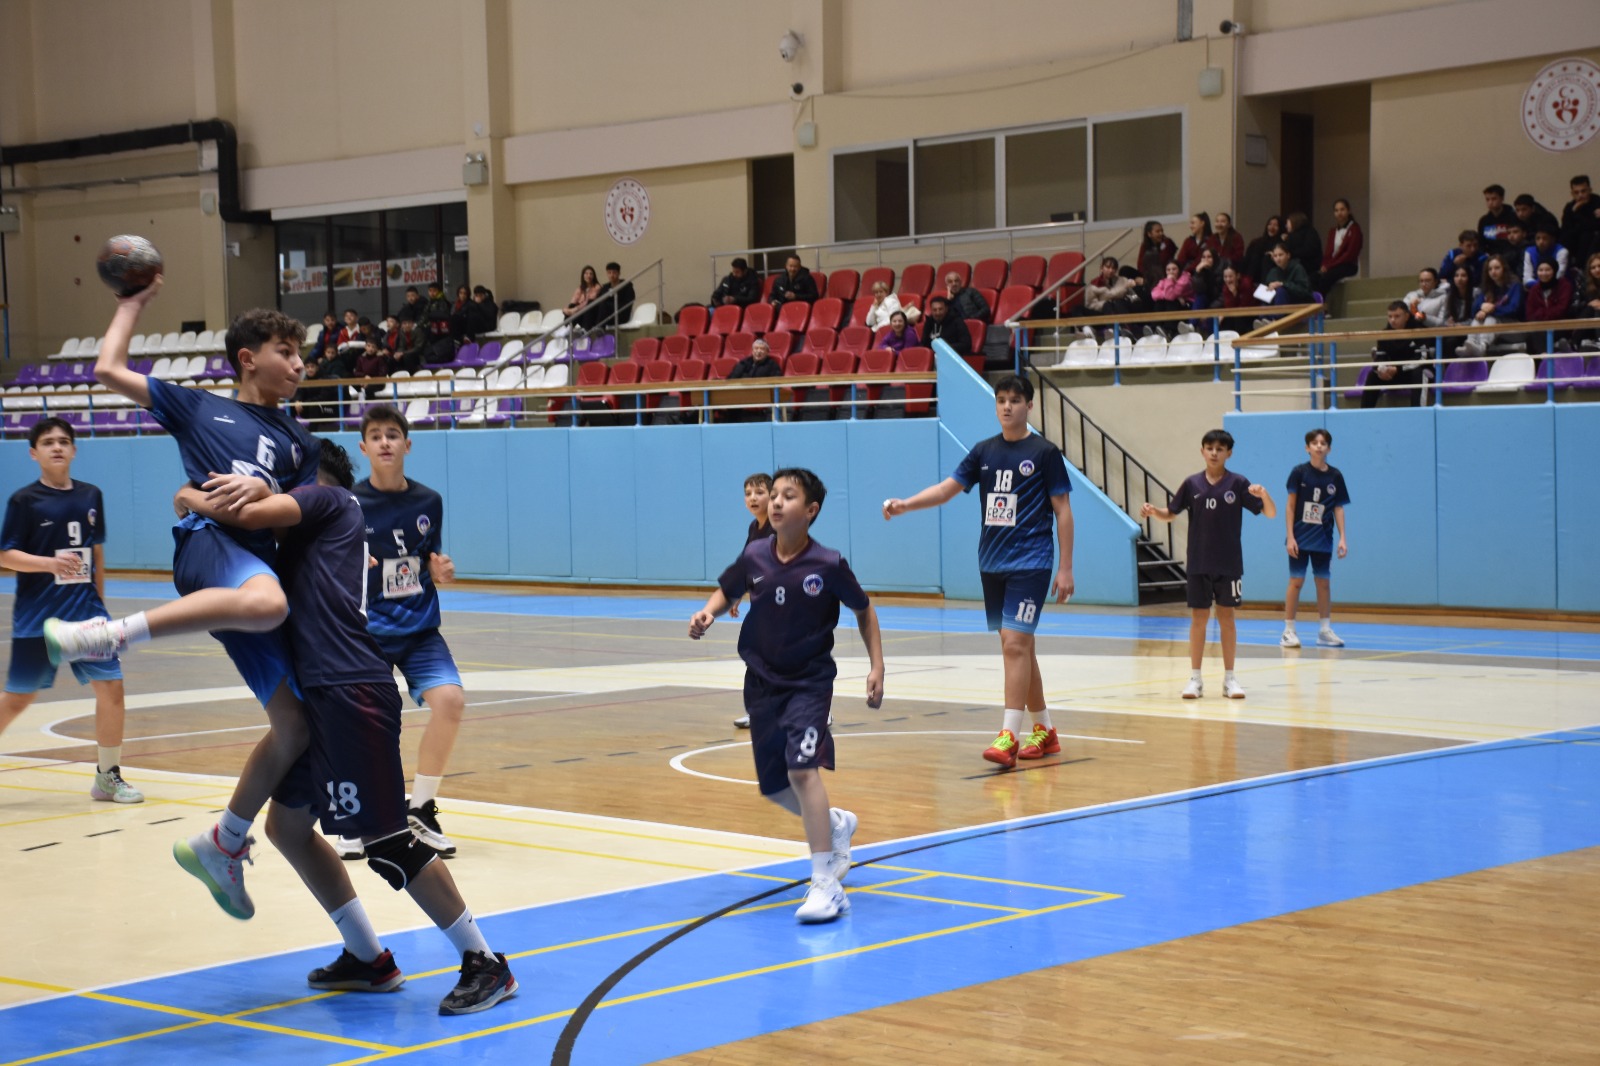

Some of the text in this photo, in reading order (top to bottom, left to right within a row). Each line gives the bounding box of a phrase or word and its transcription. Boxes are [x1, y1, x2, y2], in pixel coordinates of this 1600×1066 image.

[355, 278, 380, 288] TOST
[256, 434, 276, 471] 6
[994, 469, 1013, 492] 18
[1205, 498, 1217, 509] 10
[67, 521, 82, 546] 9
[392, 529, 407, 556] 5
[775, 586, 786, 606] 8
[1231, 579, 1242, 597] 10
[1015, 601, 1036, 624] 18
[800, 726, 818, 757] 8
[326, 781, 361, 815] 18
